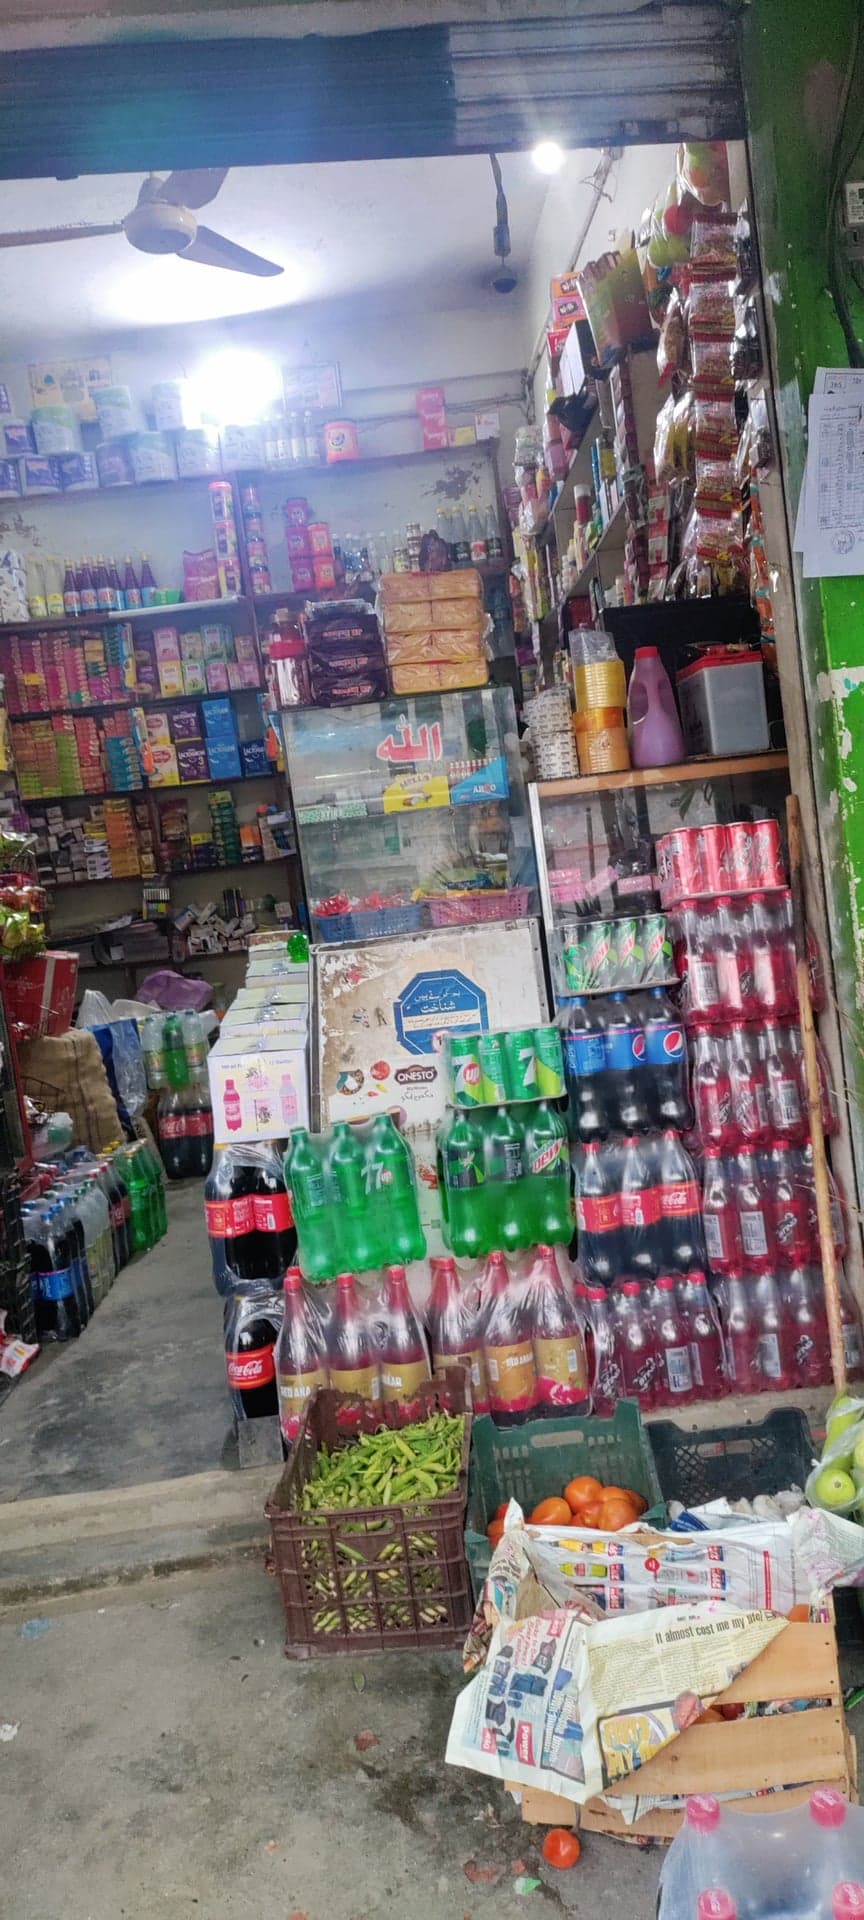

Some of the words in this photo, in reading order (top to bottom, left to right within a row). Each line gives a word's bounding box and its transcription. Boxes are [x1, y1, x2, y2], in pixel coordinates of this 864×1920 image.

[376, 714, 444, 762] الله
[397, 1070, 434, 1082] ONESTO
[665, 1627, 694, 1643] almost
[696, 1623, 715, 1635] cost
[716, 1621, 730, 1633] me
[732, 1618, 745, 1630] my
